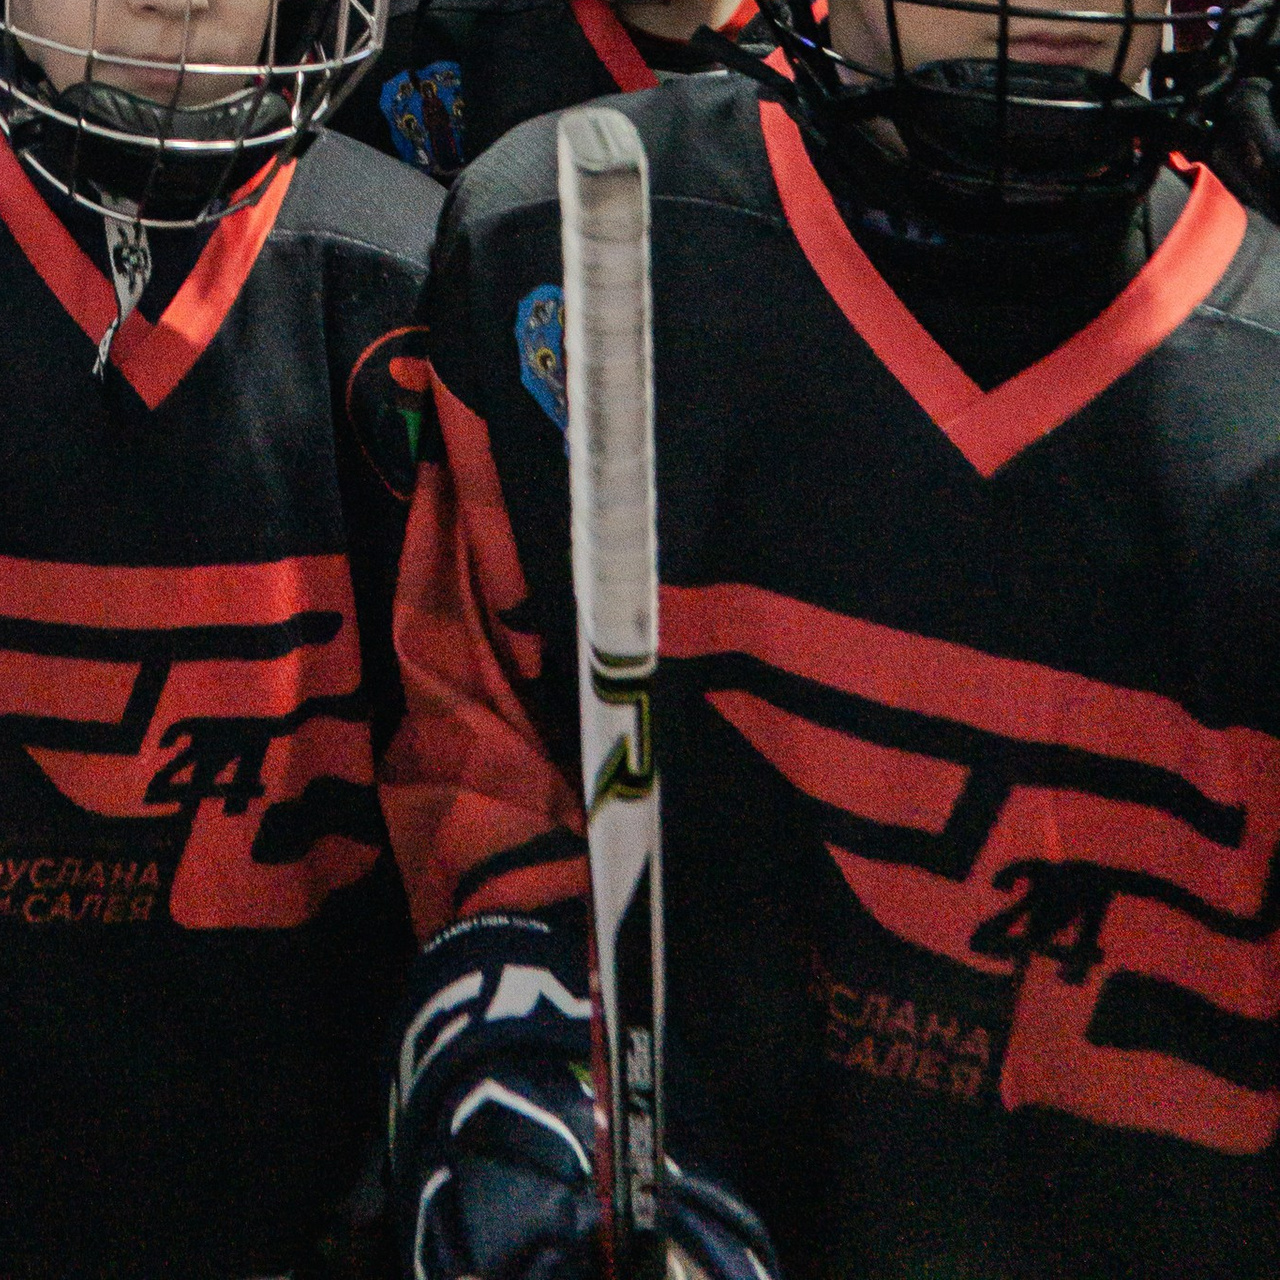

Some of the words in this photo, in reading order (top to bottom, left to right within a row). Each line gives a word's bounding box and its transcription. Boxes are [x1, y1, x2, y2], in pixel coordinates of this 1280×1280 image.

[143, 716, 266, 817] 24
[22, 892, 155, 923] САЛЕЯ
[969, 858, 1106, 986] 24
